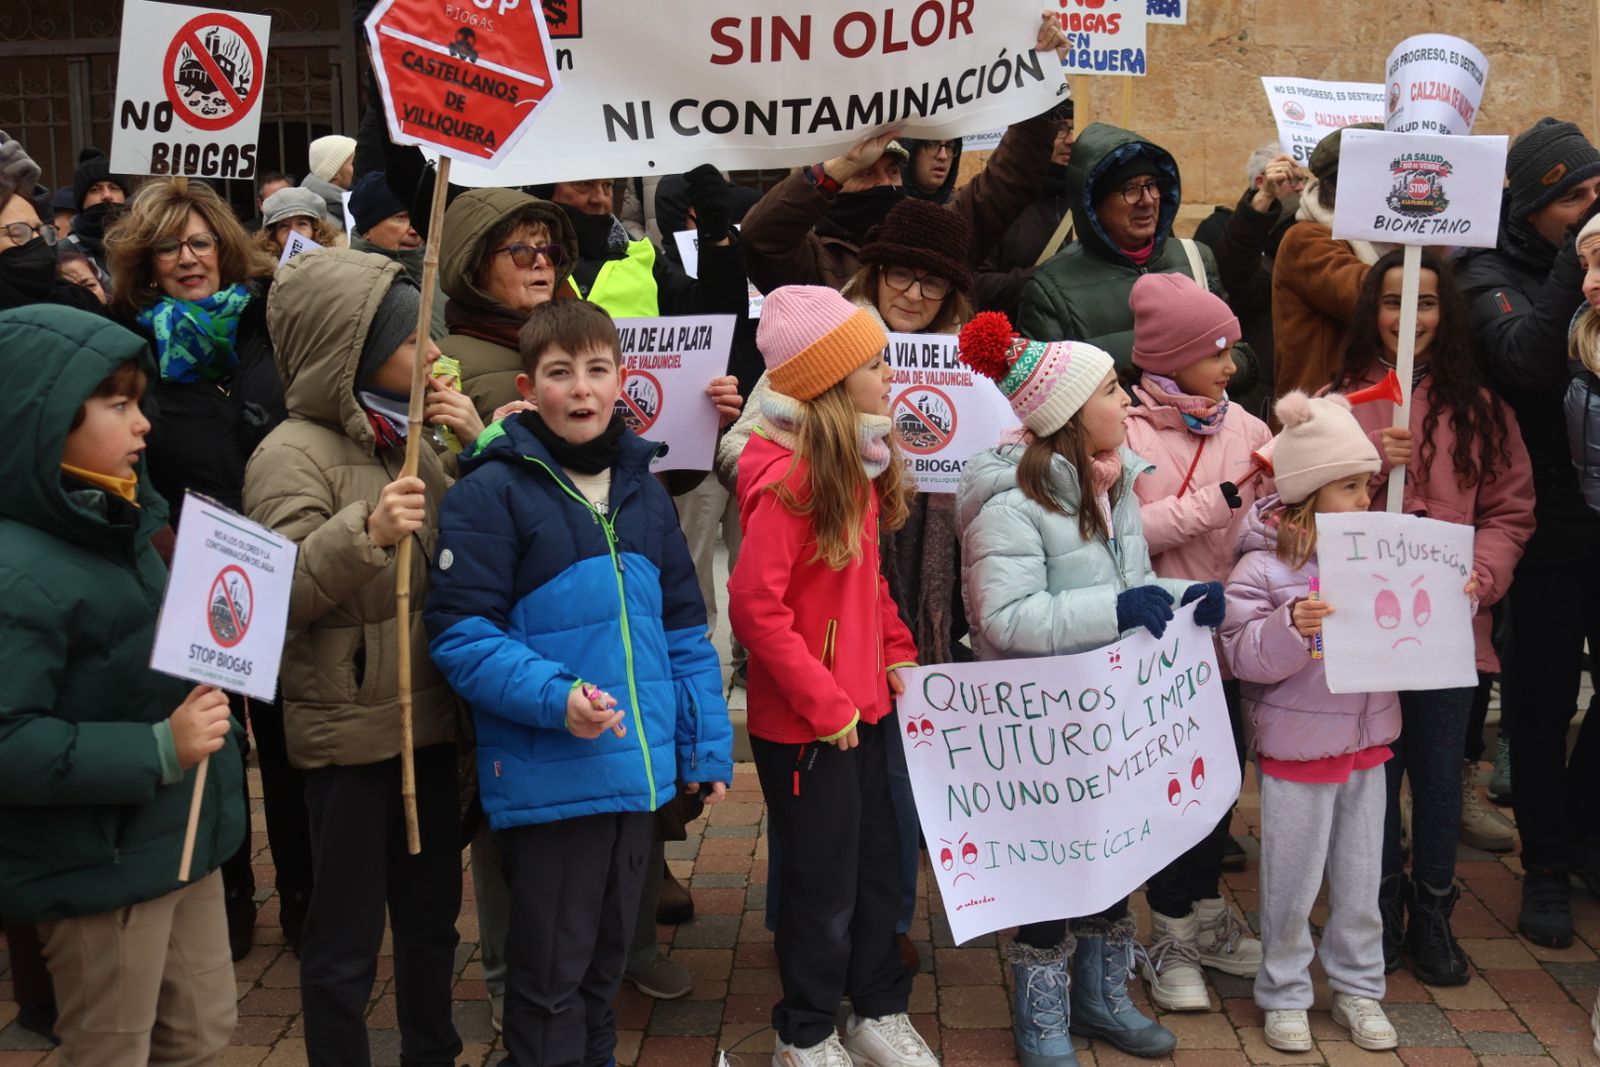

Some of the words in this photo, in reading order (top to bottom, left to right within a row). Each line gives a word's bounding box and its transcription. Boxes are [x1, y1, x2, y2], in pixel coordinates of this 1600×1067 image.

[446, 4, 495, 32] BIOGAS
[1056, 12, 1122, 35] IOGAS
[709, 15, 812, 65] SIN
[833, 0, 975, 59] OLOR
[401, 50, 519, 102] CASTELLANOS
[444, 91, 467, 113] DE
[602, 100, 655, 142] NI
[669, 48, 1046, 137] CONTAMINACIÓN
[1274, 85, 1286, 94] NO
[1287, 86, 1296, 95] ES
[1336, 91, 1346, 101] ES
[1410, 81, 1451, 105] CALZADA
[120, 99, 174, 133] NO
[402, 103, 497, 147] VILLIQUERA
[1422, 121, 1437, 131] NO
[151, 142, 257, 178] BIOGAS
[1401, 153, 1413, 161] LA
[1414, 153, 1444, 163] SALUD
[1408, 182, 1430, 194] STOP
[1373, 215, 1472, 235] BIOMETANO
[638, 327, 658, 352] DE
[658, 327, 675, 352] LA
[676, 325, 713, 352] PLATA
[627, 356, 638, 369] DE
[639, 354, 682, 369] VALDUNCIEL
[895, 342, 918, 368] VIA
[922, 344, 940, 369] DE
[943, 345, 960, 369] LA
[913, 370, 923, 385] DE
[925, 371, 974, 387] VALDUNCIEL
[1343, 531, 1468, 577] Injusticia
[188, 643, 216, 665] STOP
[216, 653, 253, 676] BIOGAS
[922, 672, 1117, 720] QUEREMOS
[1137, 638, 1180, 686] UN
[941, 722, 1113, 771] FUTURO
[1121, 660, 1212, 741] LIMPIO
[946, 781, 991, 822] NO
[996, 780, 1060, 811] UNO
[1065, 774, 1105, 803] DE
[1106, 715, 1200, 794] MIERDA
